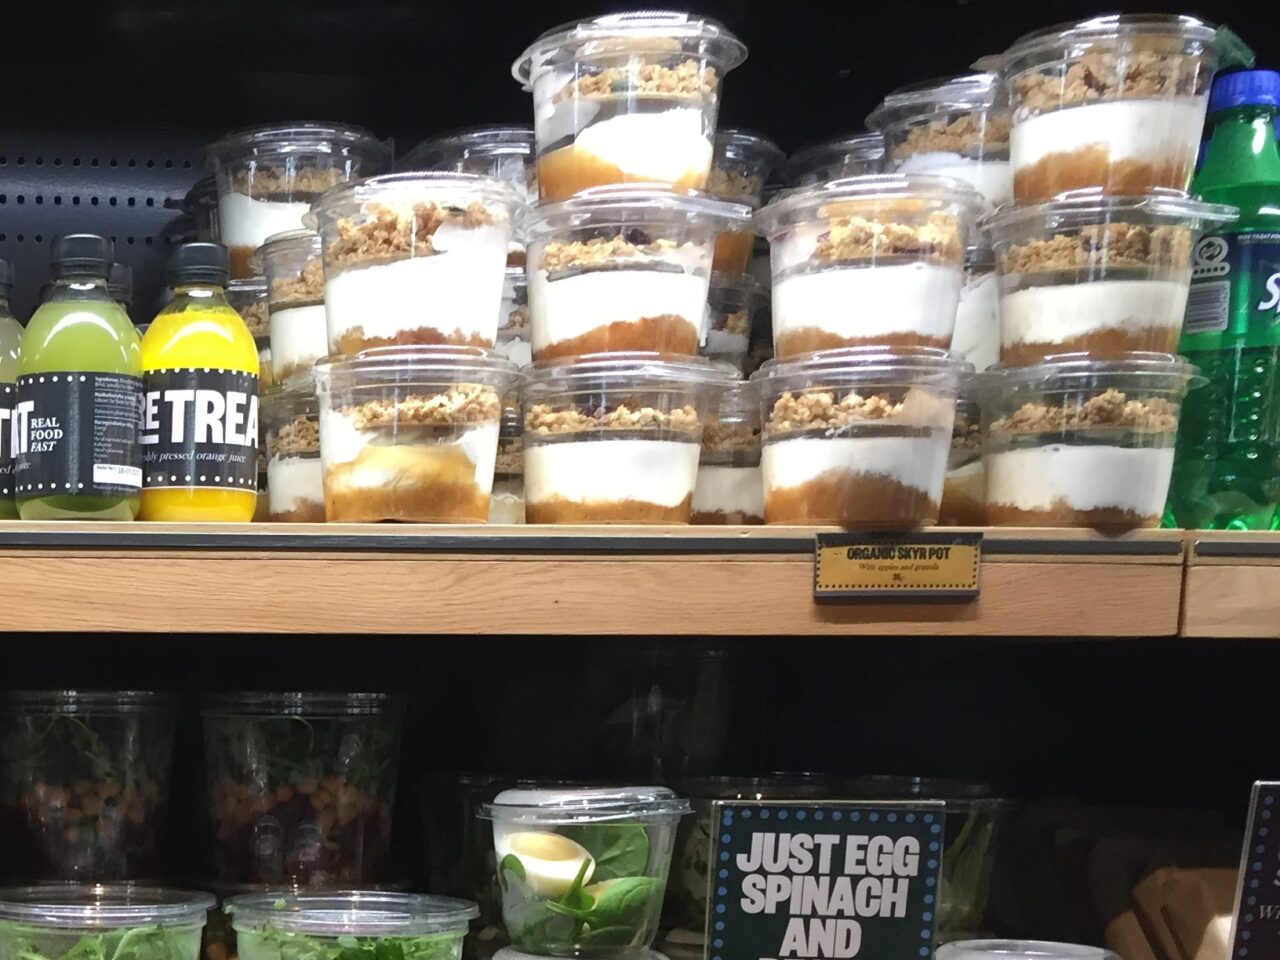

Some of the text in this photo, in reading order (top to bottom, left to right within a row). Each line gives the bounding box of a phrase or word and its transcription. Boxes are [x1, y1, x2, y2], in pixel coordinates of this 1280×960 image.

[31, 417, 60, 430] REAL
[31, 429, 63, 441] FOOD
[30, 441, 56, 453] FAST
[847, 547, 951, 560] ORGANIC SKYR POT
[736, 832, 920, 877] JUST EGG
[740, 874, 910, 918] SPINACH
[779, 918, 862, 959] AND
